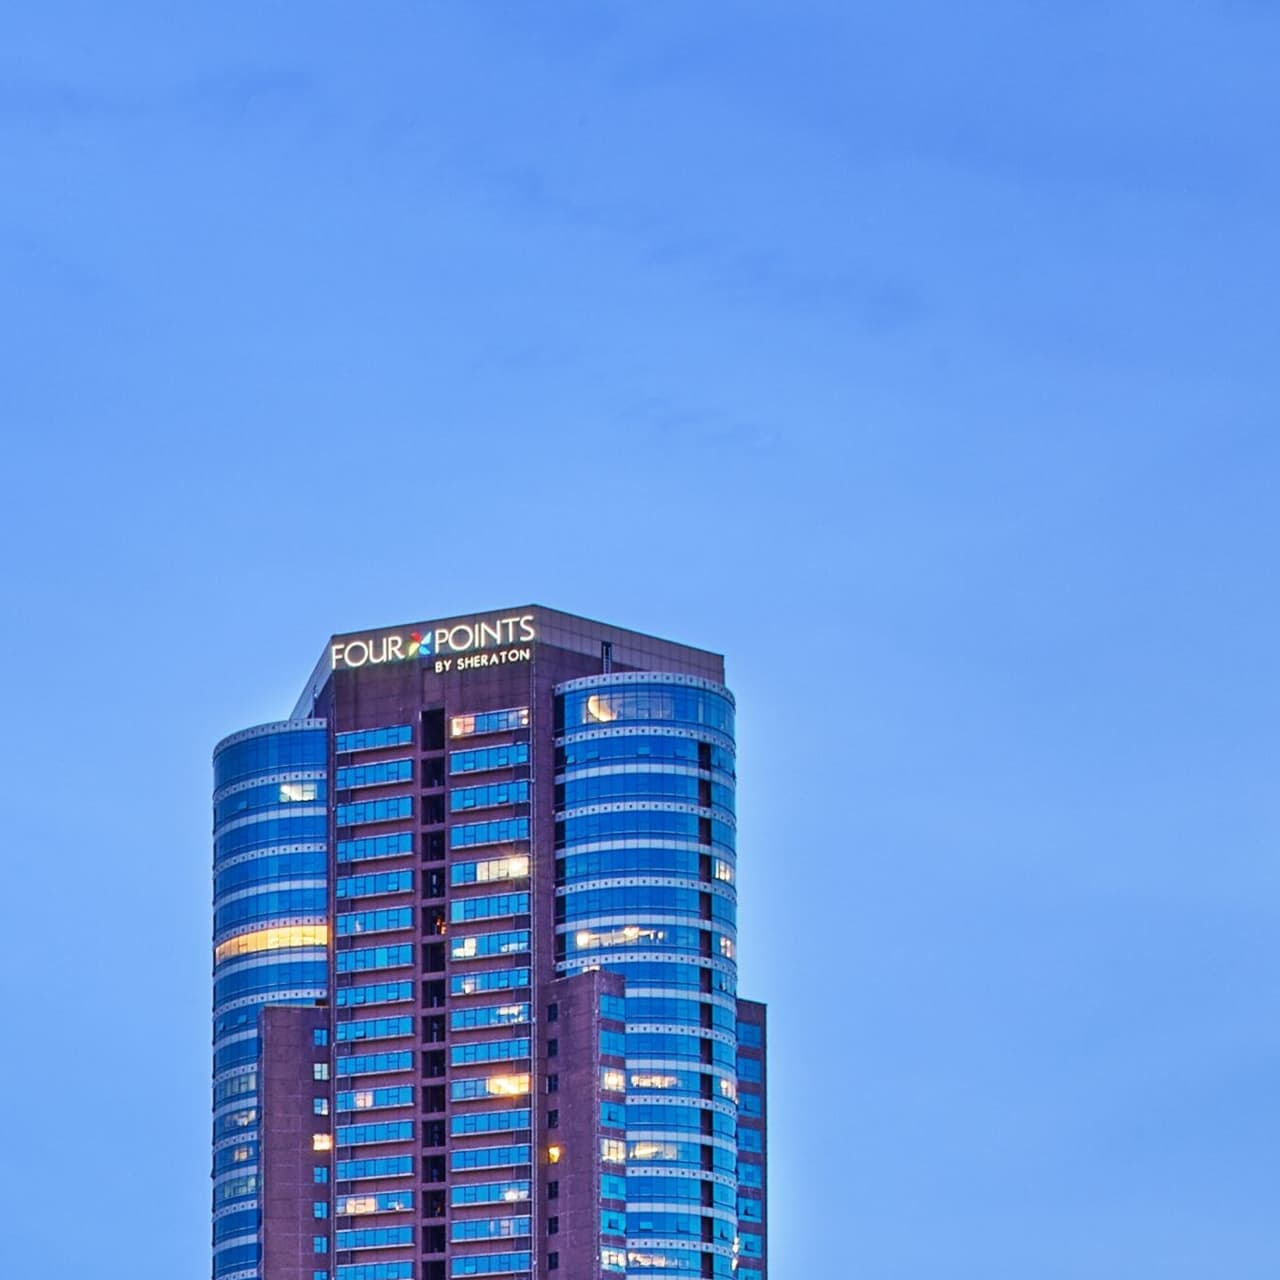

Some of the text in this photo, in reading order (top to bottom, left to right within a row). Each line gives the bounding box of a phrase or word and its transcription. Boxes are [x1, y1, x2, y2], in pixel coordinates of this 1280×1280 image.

[331, 616, 535, 669] FOUR POINTS
[435, 648, 531, 674] BY SHERATON
